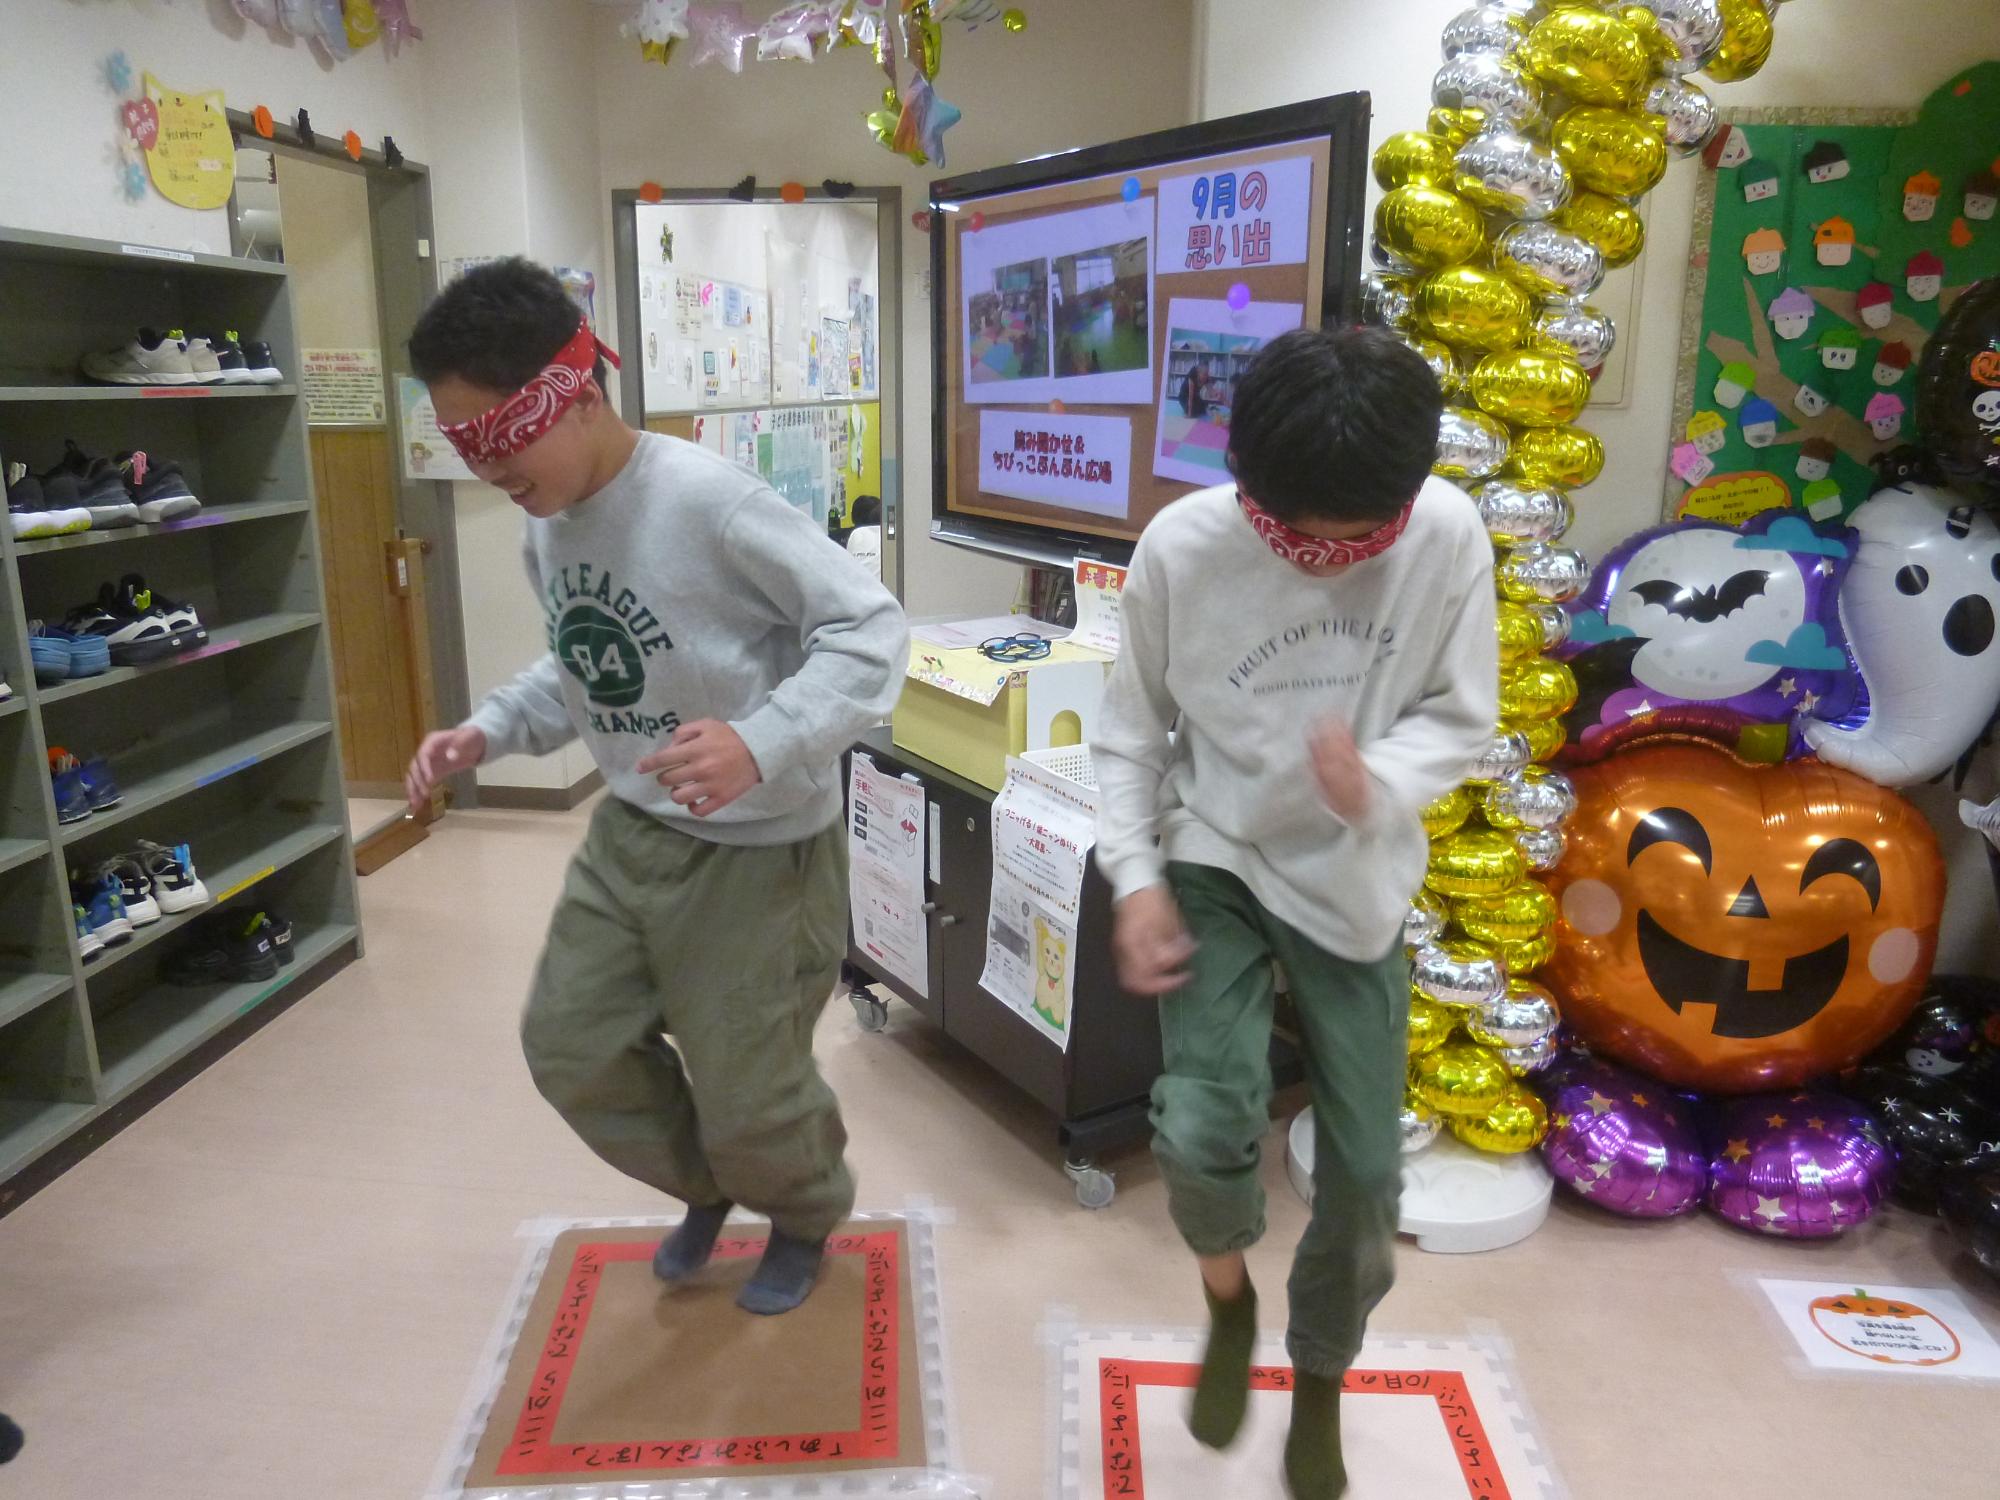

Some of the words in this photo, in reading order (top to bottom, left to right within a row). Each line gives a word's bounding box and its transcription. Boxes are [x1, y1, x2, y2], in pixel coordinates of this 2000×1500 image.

[1191, 170, 1268, 221] 9月の
[1185, 218, 1272, 270] 思い出
[561, 563, 674, 658] LEAGUE
[1227, 636, 1278, 689] FRUIT
[1283, 621, 1311, 646] OF
[1318, 617, 1361, 637] THE
